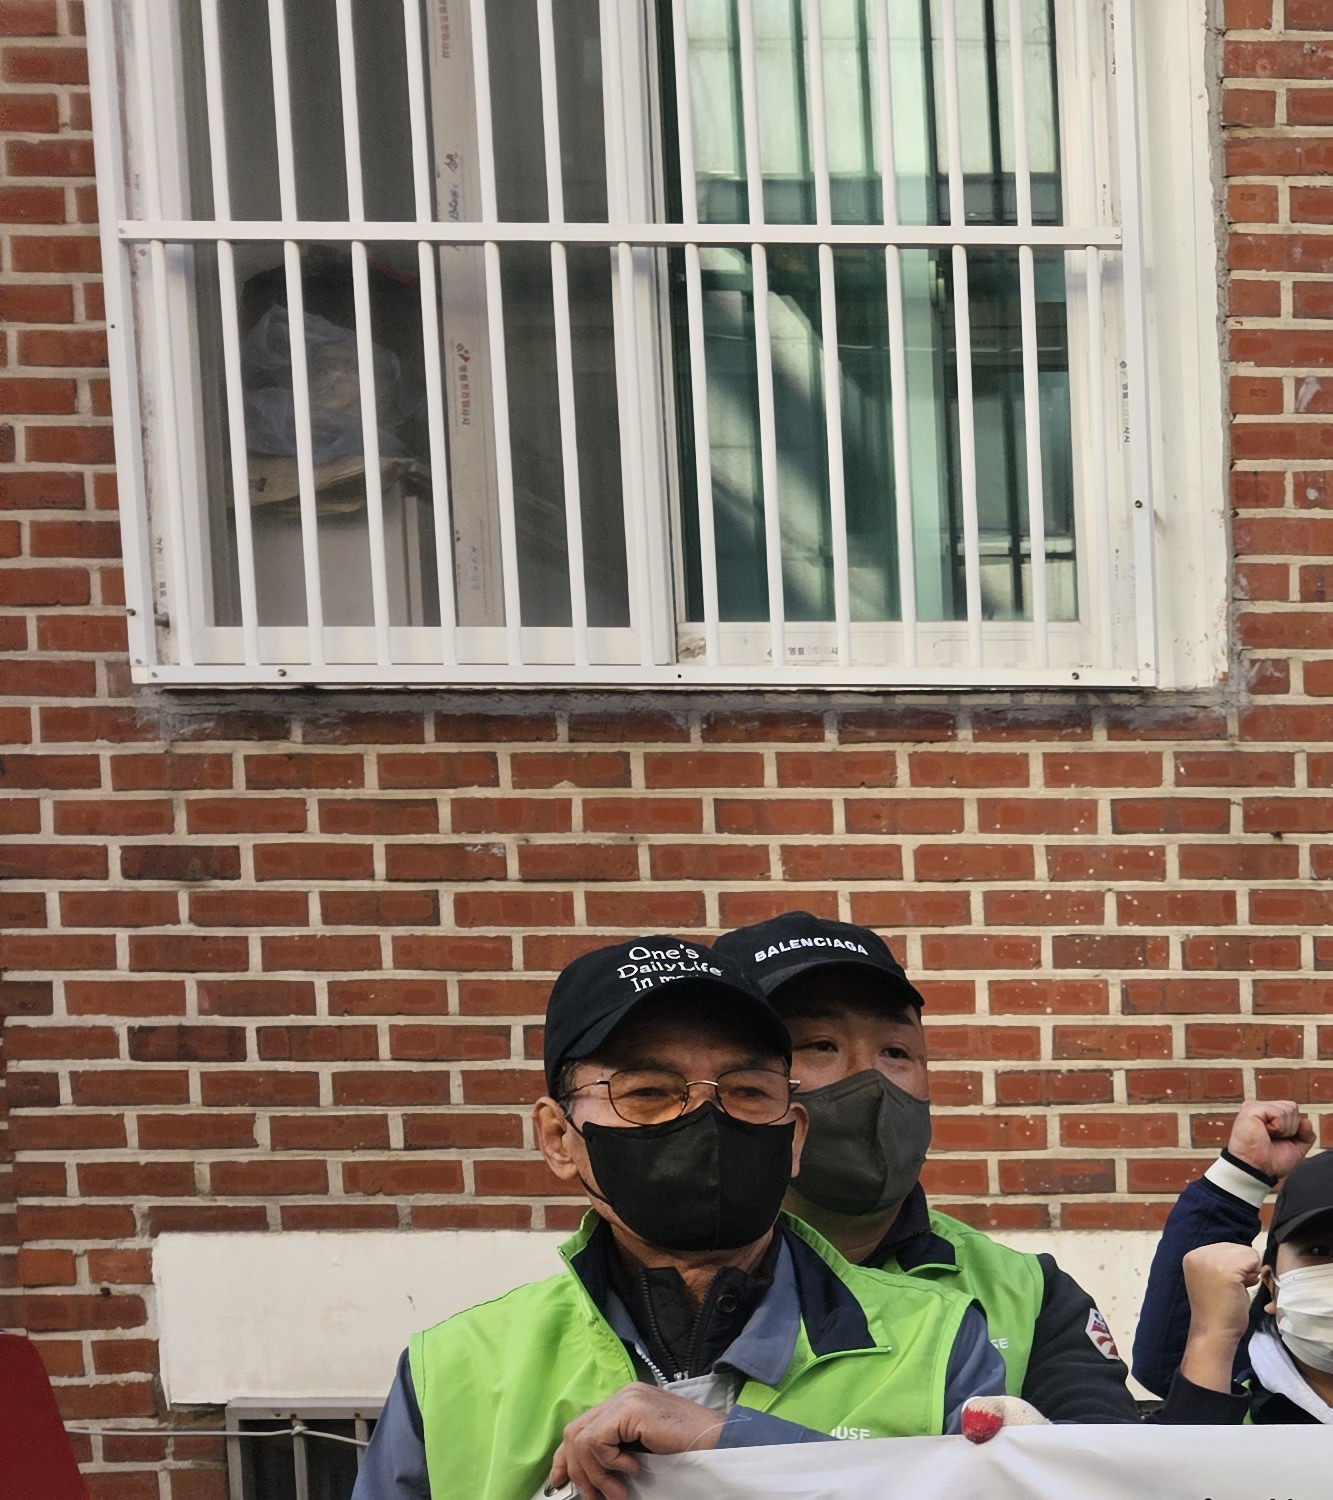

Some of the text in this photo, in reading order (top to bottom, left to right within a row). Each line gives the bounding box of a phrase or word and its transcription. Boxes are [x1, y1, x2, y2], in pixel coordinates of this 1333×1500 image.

[628, 943, 700, 962] One's
[755, 937, 870, 963] BALENCIAGA
[617, 961, 674, 980] Daily
[630, 976, 654, 992] In
